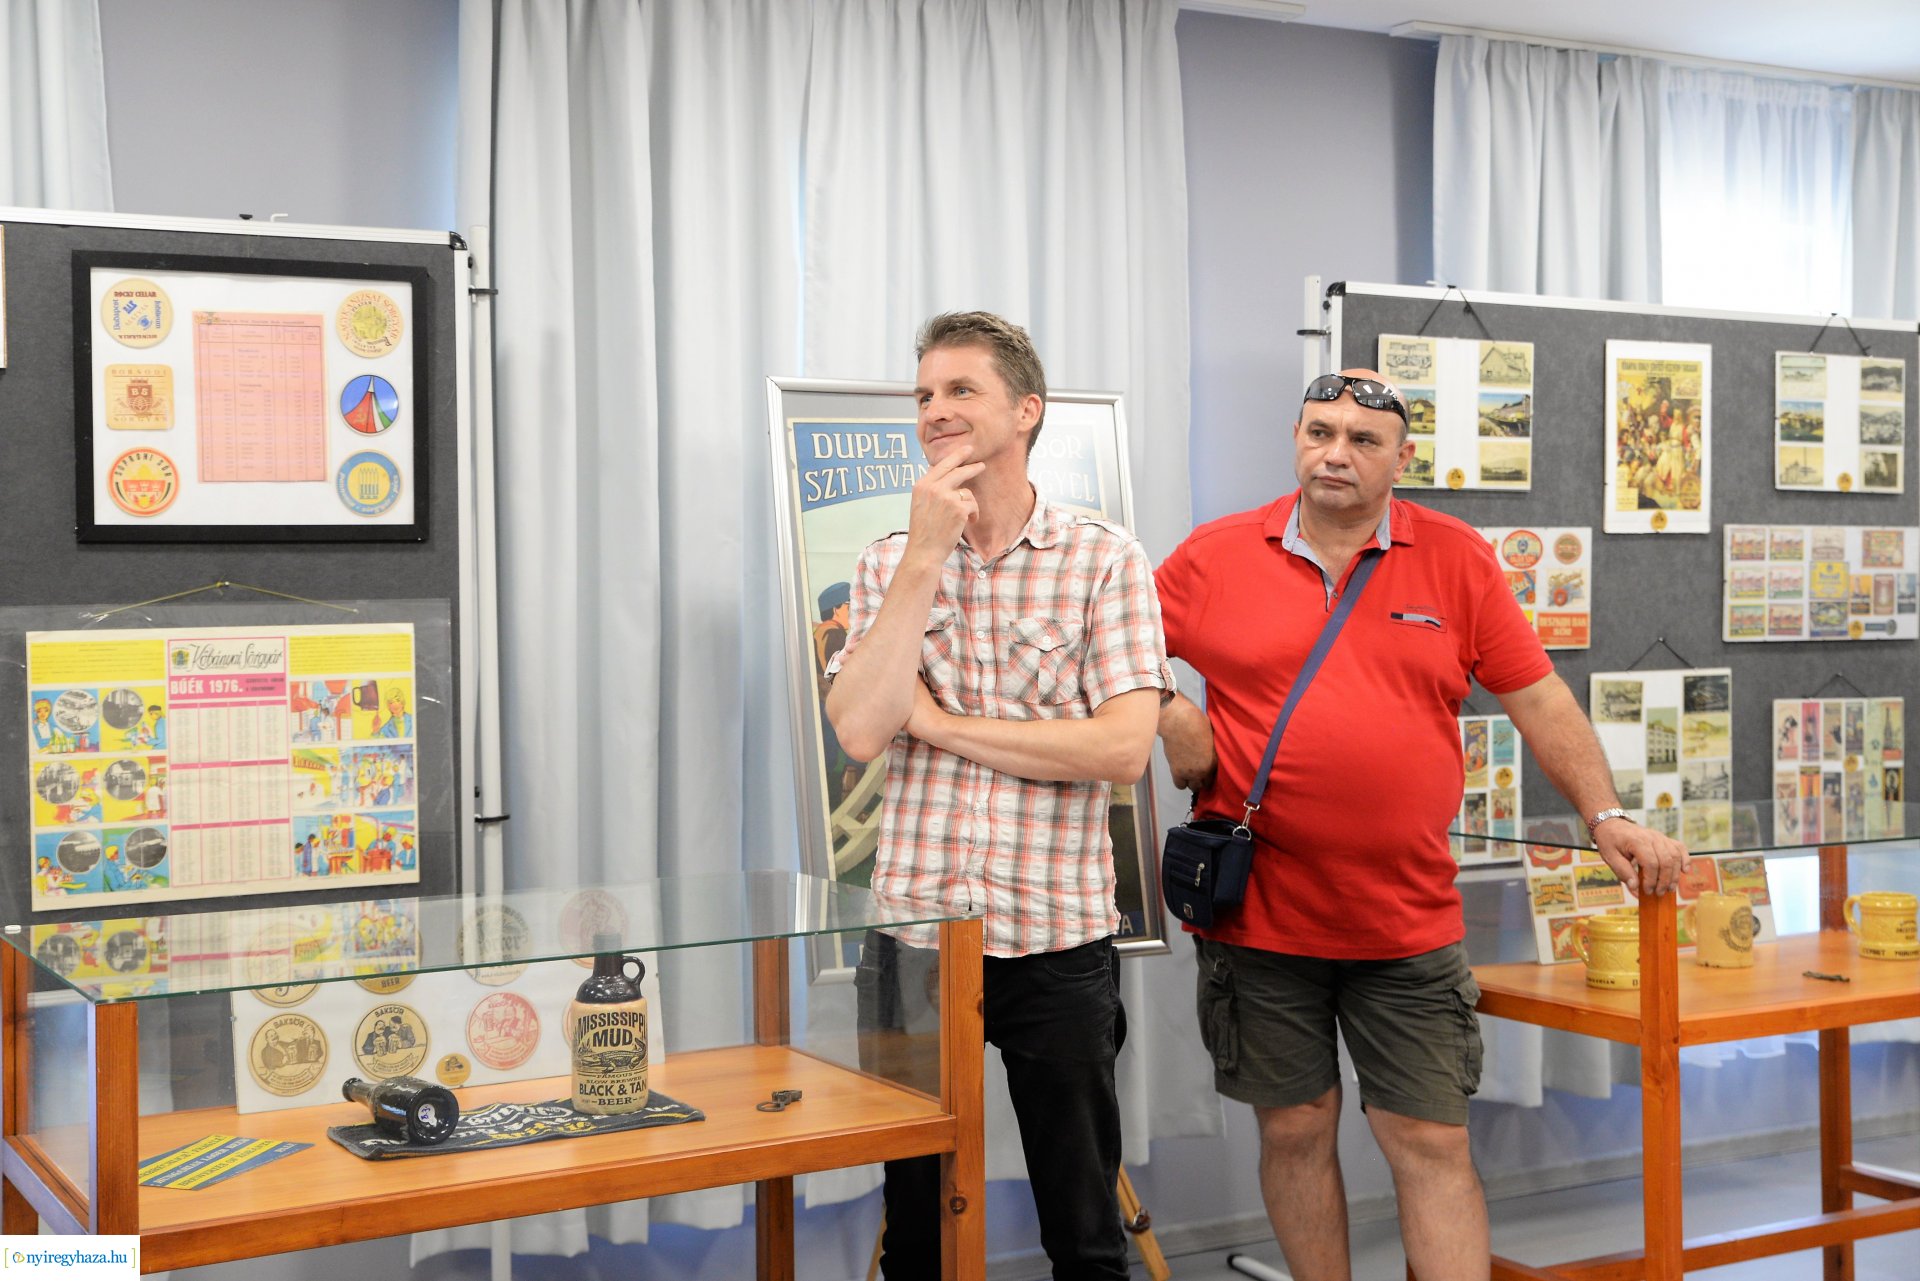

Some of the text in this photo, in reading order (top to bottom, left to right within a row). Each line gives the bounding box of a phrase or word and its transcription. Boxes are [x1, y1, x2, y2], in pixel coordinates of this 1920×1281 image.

[811, 432, 908, 459] DUPLA
[804, 467, 853, 502] SZT.
[208, 679, 244, 694] 1976.
[380, 977, 401, 988] BEER
[374, 1006, 405, 1018] BAKSÖR
[592, 1028, 633, 1047] MUD
[579, 1079, 647, 1097] BLACK & TAN
[597, 1096, 632, 1106] BEER
